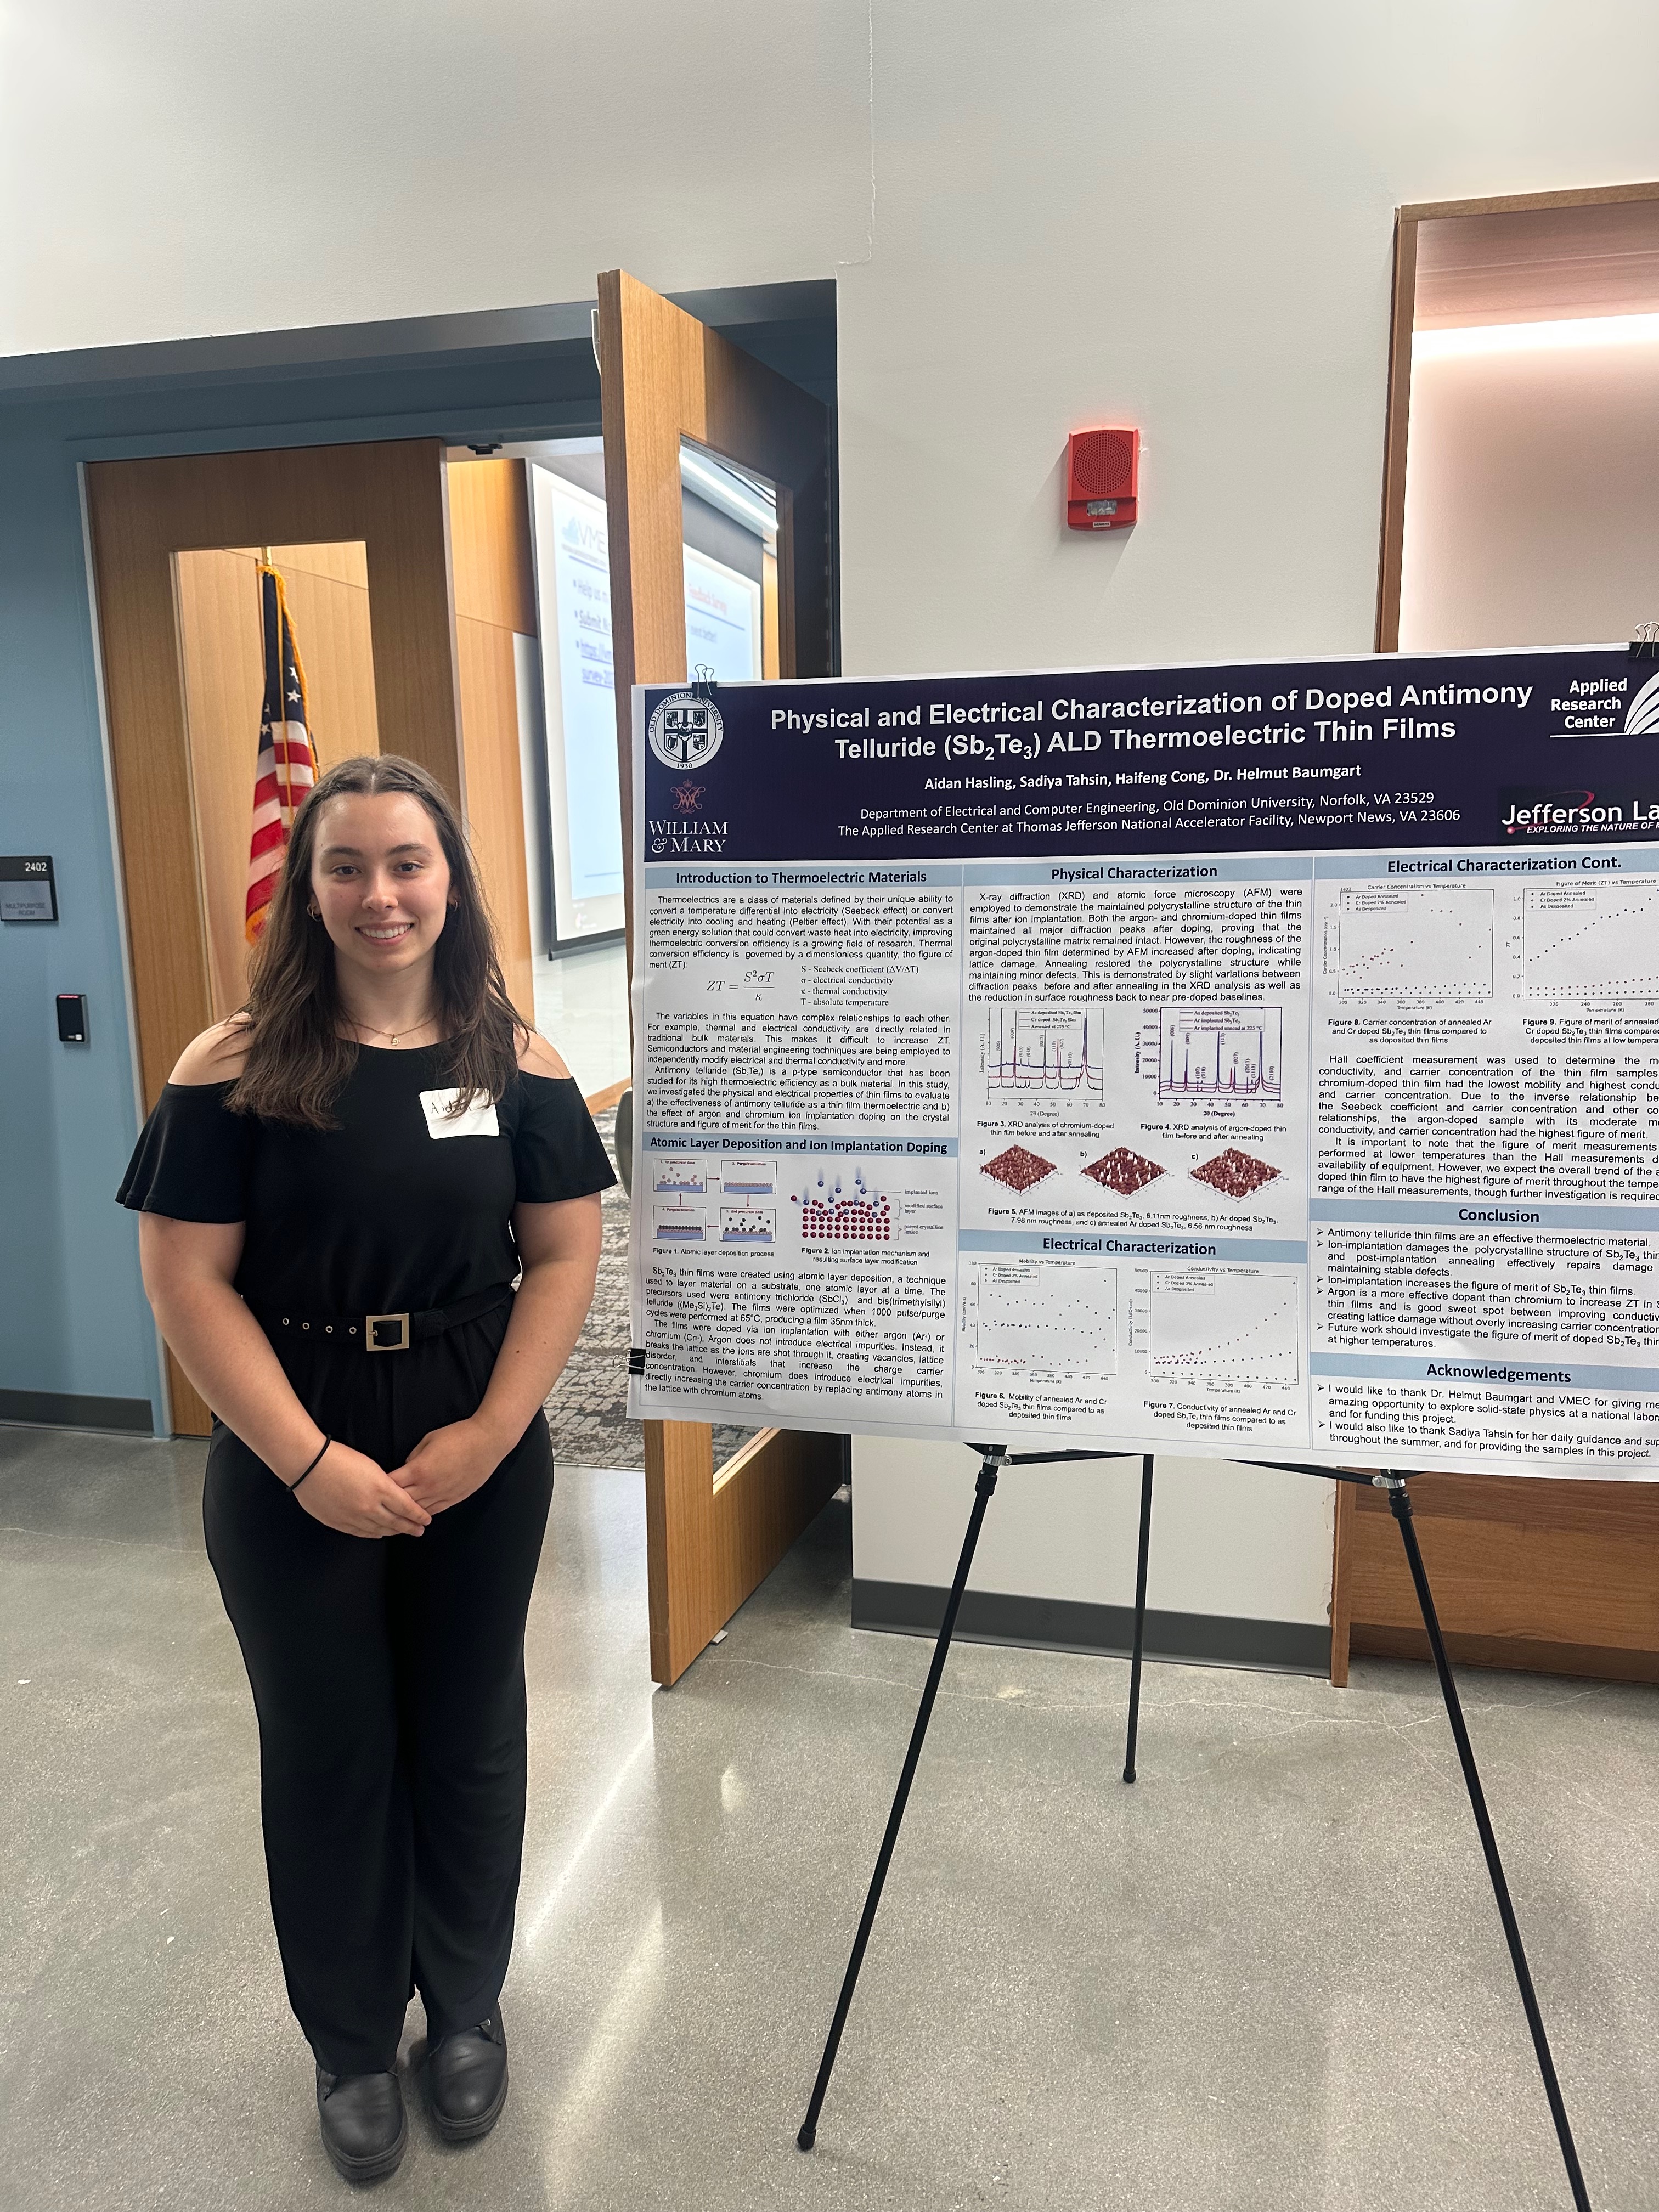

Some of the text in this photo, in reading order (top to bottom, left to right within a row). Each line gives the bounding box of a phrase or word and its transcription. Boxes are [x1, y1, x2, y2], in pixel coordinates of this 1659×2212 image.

[578, 521, 606, 555] VME
[1569, 678, 1627, 696] Applied
[771, 685, 1533, 734] Physical and Electrical Characterization of Doped Antimony
[1551, 696, 1621, 711] Research
[649, 716, 657, 733] OLD
[654, 692, 692, 715] DOMINION
[1565, 715, 1616, 729] Center
[835, 736, 936, 758] Telluride
[1047, 731, 1101, 752] ALD
[1109, 723, 1306, 749] Thermoelectric
[1314, 720, 1372, 742] Thin
[1384, 718, 1455, 740] Films
[924, 765, 1362, 790] Aidan Hasling, Sadiya Tahsin, Haifeng Cong, Dr. Helmut Baumgart
[861, 792, 1434, 821] Department of Electrical and Computer Engineering, Old Dominion University, Norfolk, VA 23529
[1502, 800, 1659, 825] Jefferson La
[648, 820, 728, 835] WILLIAM
[838, 810, 1460, 838] The Applied Research Center at Thomas Jefferson National Accelerator Facility, Newport News, VA 23606
[1527, 825, 1578, 833] EXPLORING
[1581, 823, 1599, 832] THE
[1601, 822, 1640, 831] NATURE
[1640, 821, 1655, 830] OF
[652, 837, 726, 853] & MARY
[25, 862, 48, 872] 2402
[1388, 857, 1622, 872] Electrical Characterization Cont.
[676, 870, 927, 883] Introduction to Thermoelectric Materials
[1052, 865, 1217, 882] Physical Characterization
[771, 895, 779, 904] of
[782, 895, 818, 904] materials
[821, 895, 850, 904] defined
[854, 895, 864, 905] by
[888, 895, 915, 904] unique
[918, 895, 943, 904] ability
[980, 893, 1002, 902] X-ray
[1009, 892, 1050, 901] diffraction
[1058, 891, 1085, 901] (XRD)
[1154, 890, 1176, 899] force
[1184, 890, 1235, 899] microscopy
[1244, 888, 1272, 898] (AFM)
[1328, 1019, 1352, 1027] Figure
[977, 1120, 998, 1128] Figure
[650, 1137, 947, 1155] Atomic Layer Deposition and Ion Implantation Doping
[1459, 1209, 1539, 1222] Conclusion
[1328, 1228, 1372, 1240] Antimony
[1374, 1230, 1412, 1239] telluride
[1414, 1231, 1431, 1240] thin
[1434, 1232, 1457, 1240] films
[1493, 1233, 1533, 1243] effective
[1536, 1235, 1605, 1245] thermoelectric
[1609, 1238, 1650, 1246] material.
[1043, 1238, 1216, 1255] Electrical Characterization
[1426, 1364, 1571, 1383] Acknowledgements
[1330, 1432, 1650, 1459] throughout the summer, and for providing the samples in this project.
